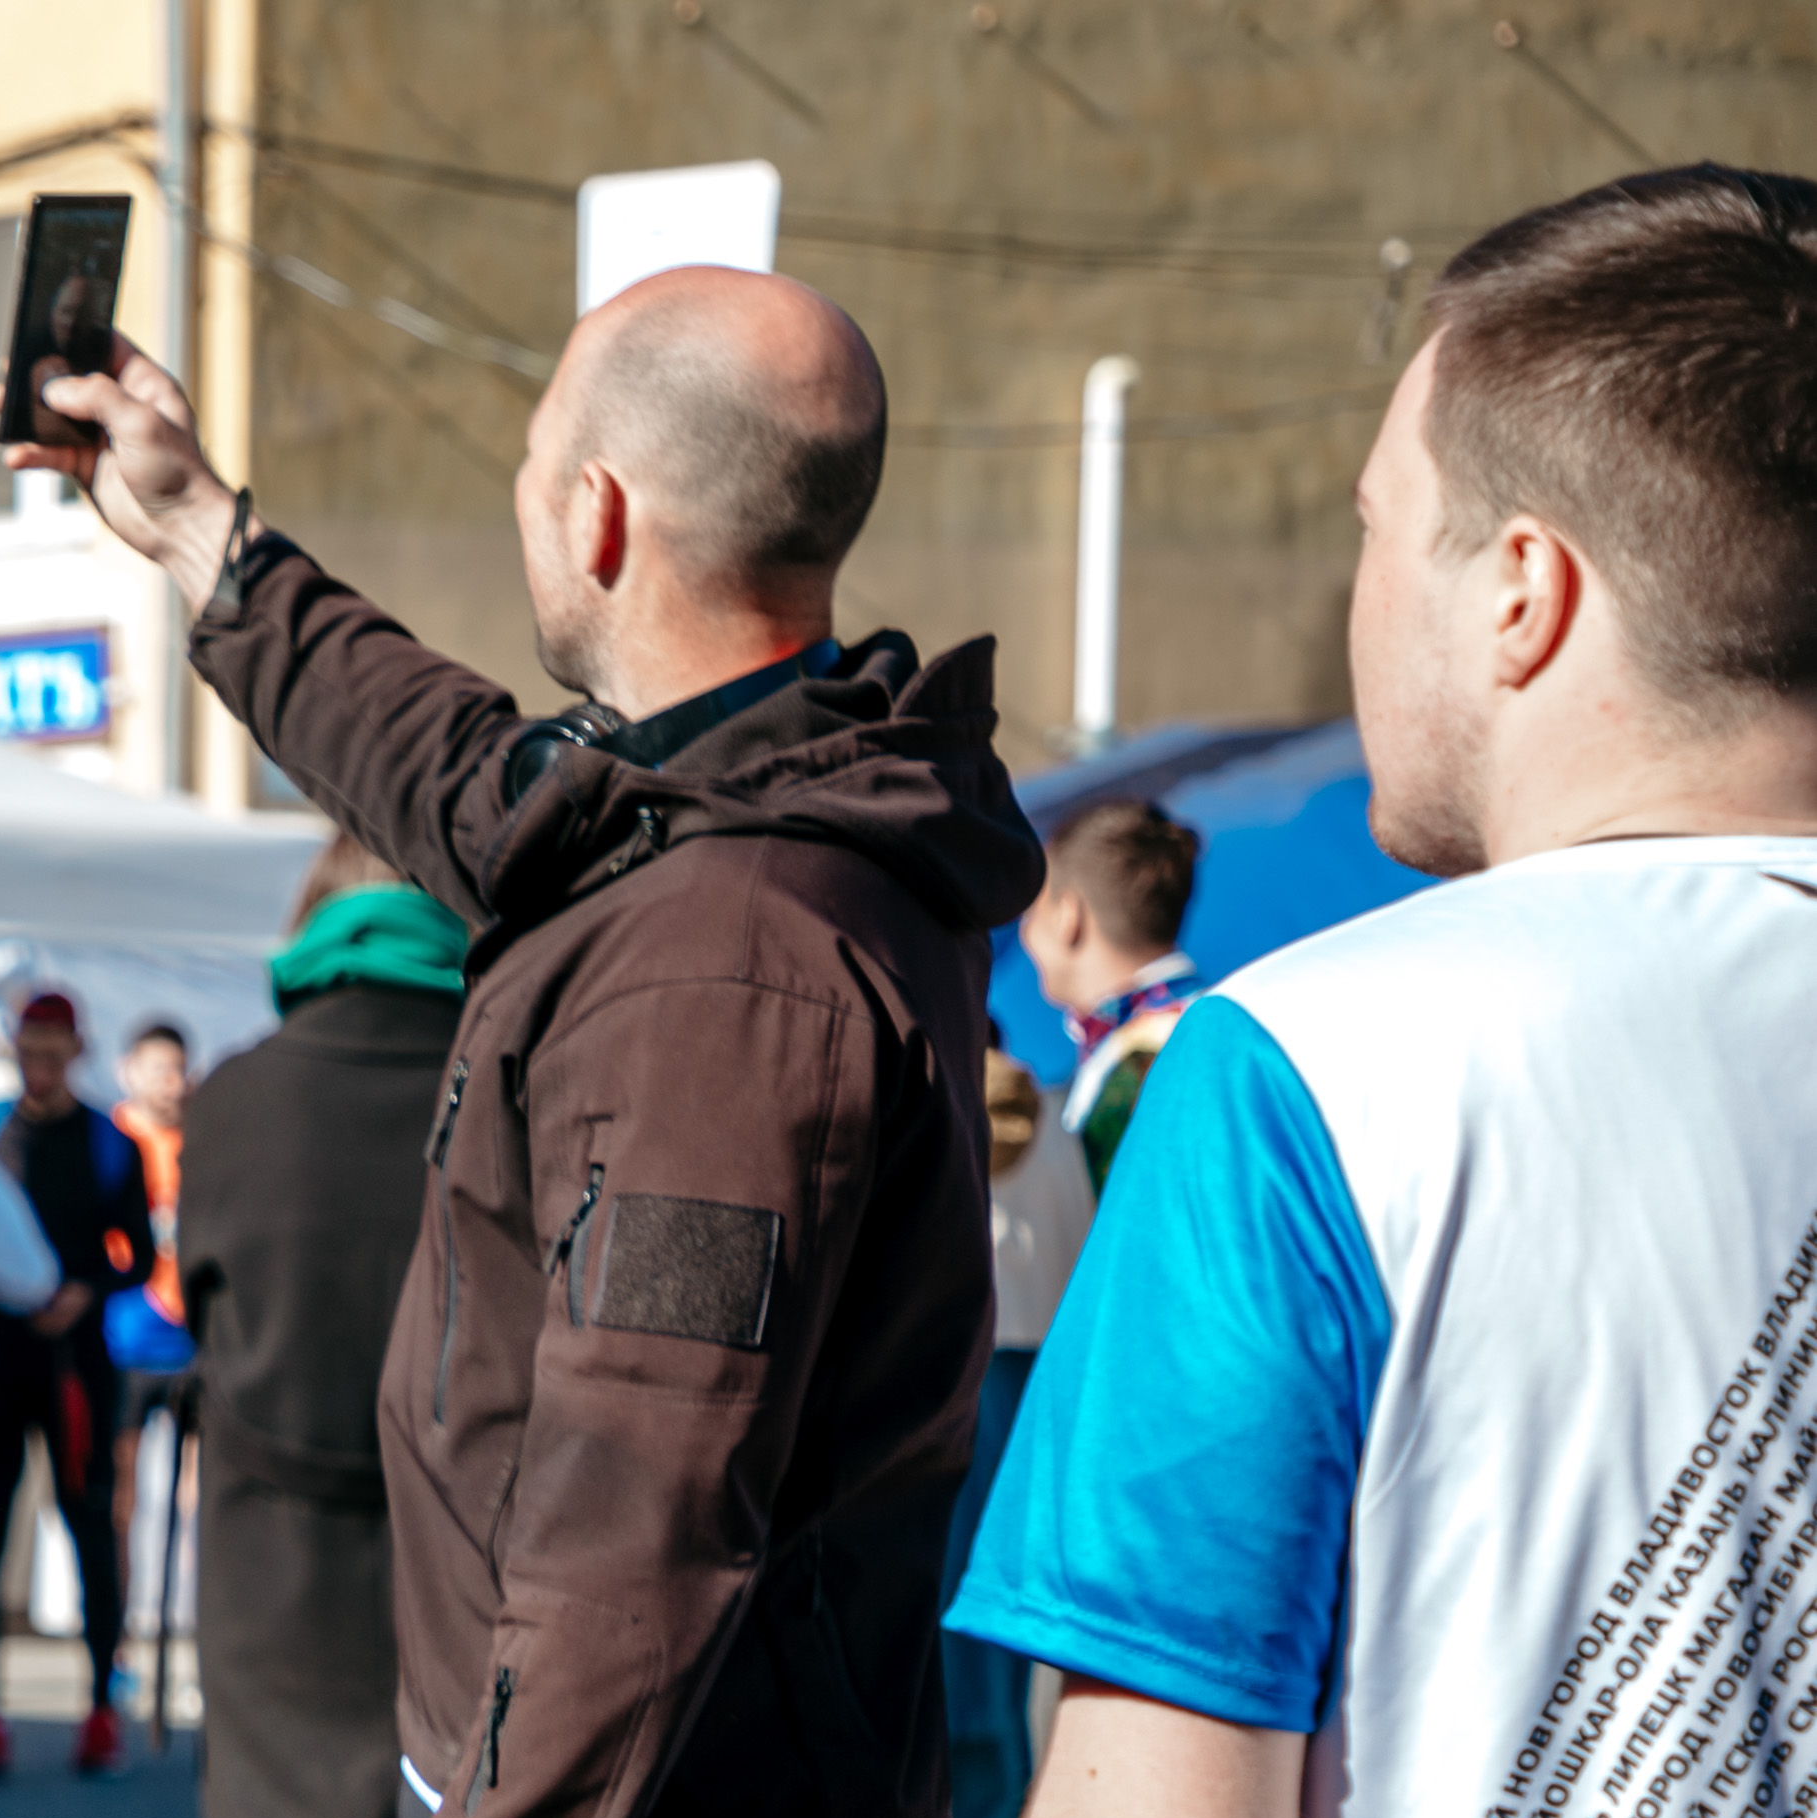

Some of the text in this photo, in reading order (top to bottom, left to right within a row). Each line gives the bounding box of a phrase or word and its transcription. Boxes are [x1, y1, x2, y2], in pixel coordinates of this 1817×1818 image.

[1502, 1609, 1625, 1798] НОВГОРОД
[1608, 1358, 1766, 1609] ВЛАДИВОСТОК
[1752, 1209, 1817, 1358] ВЛАДИК
[1601, 1665, 1696, 1806] ЛИПЕЦК
[1682, 1505, 1785, 1667] МАГАДАН
[1773, 1414, 1817, 1504] МАЙ
[1657, 1481, 1749, 1610] КАЗАНЬ
[1707, 1687, 1779, 1799] ПСКОВ
